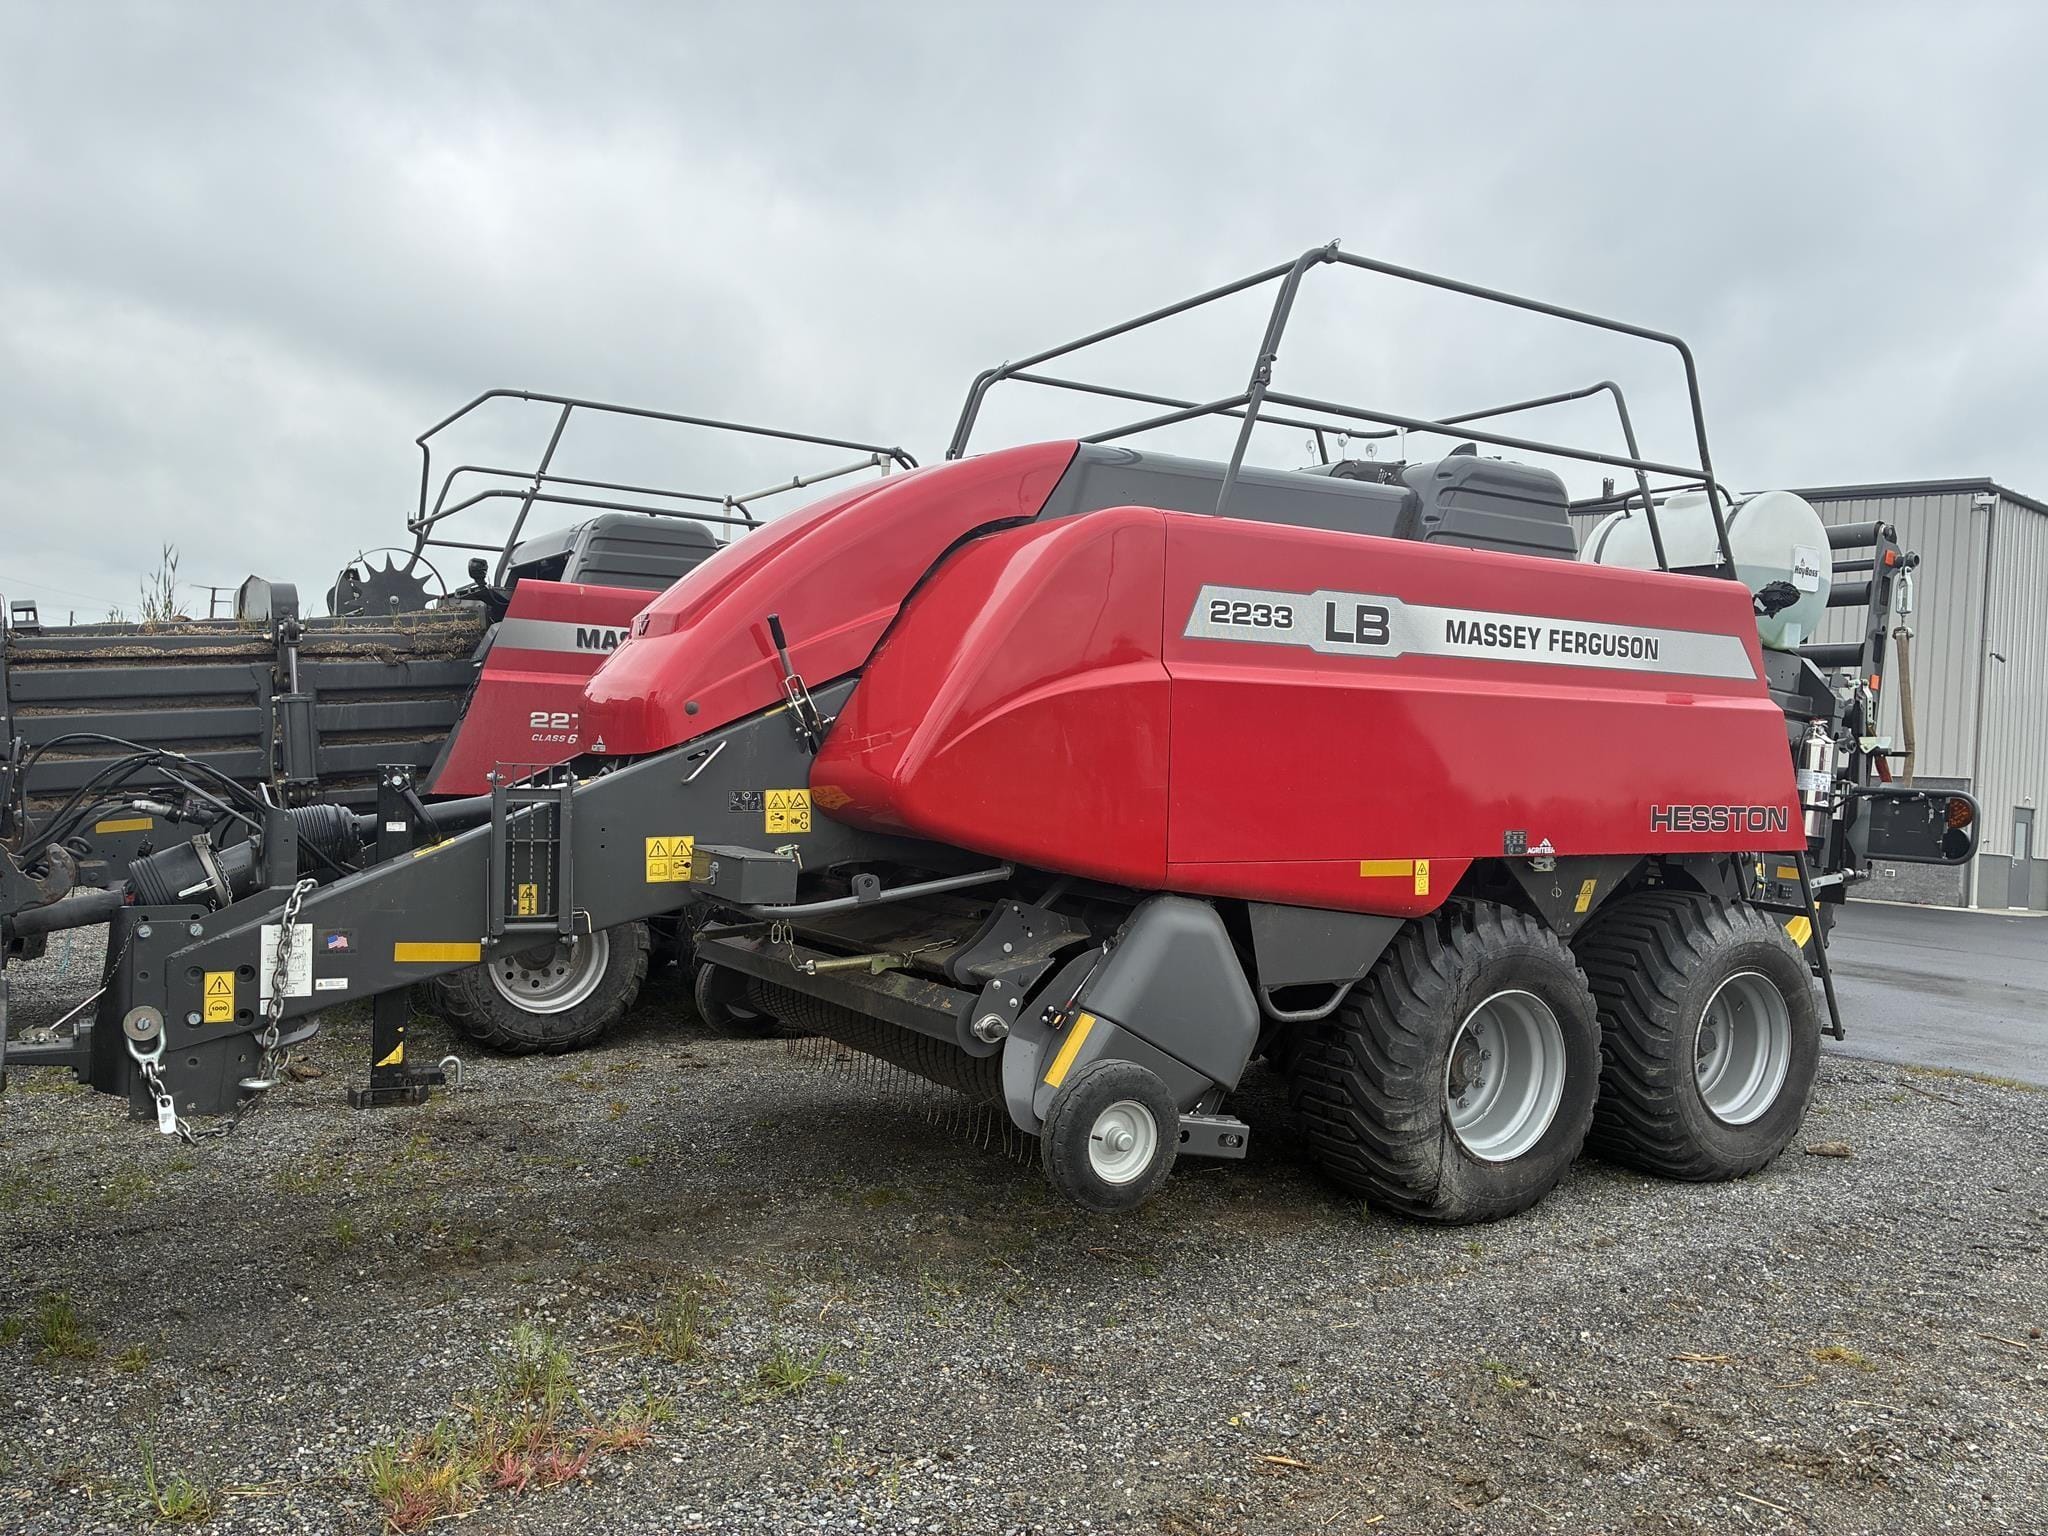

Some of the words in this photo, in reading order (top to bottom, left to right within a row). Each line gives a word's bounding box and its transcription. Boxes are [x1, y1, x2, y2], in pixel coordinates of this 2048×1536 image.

[1794, 565, 1818, 578] HayBoss
[1210, 600, 1294, 629] 2233
[1325, 601, 1390, 645] LB
[1445, 619, 1542, 650] MASSEY
[1549, 629, 1660, 660] FERGUSON
[531, 734, 566, 742] CLASS
[567, 734, 578, 744] 6
[1650, 804, 1788, 832] HESSTON
